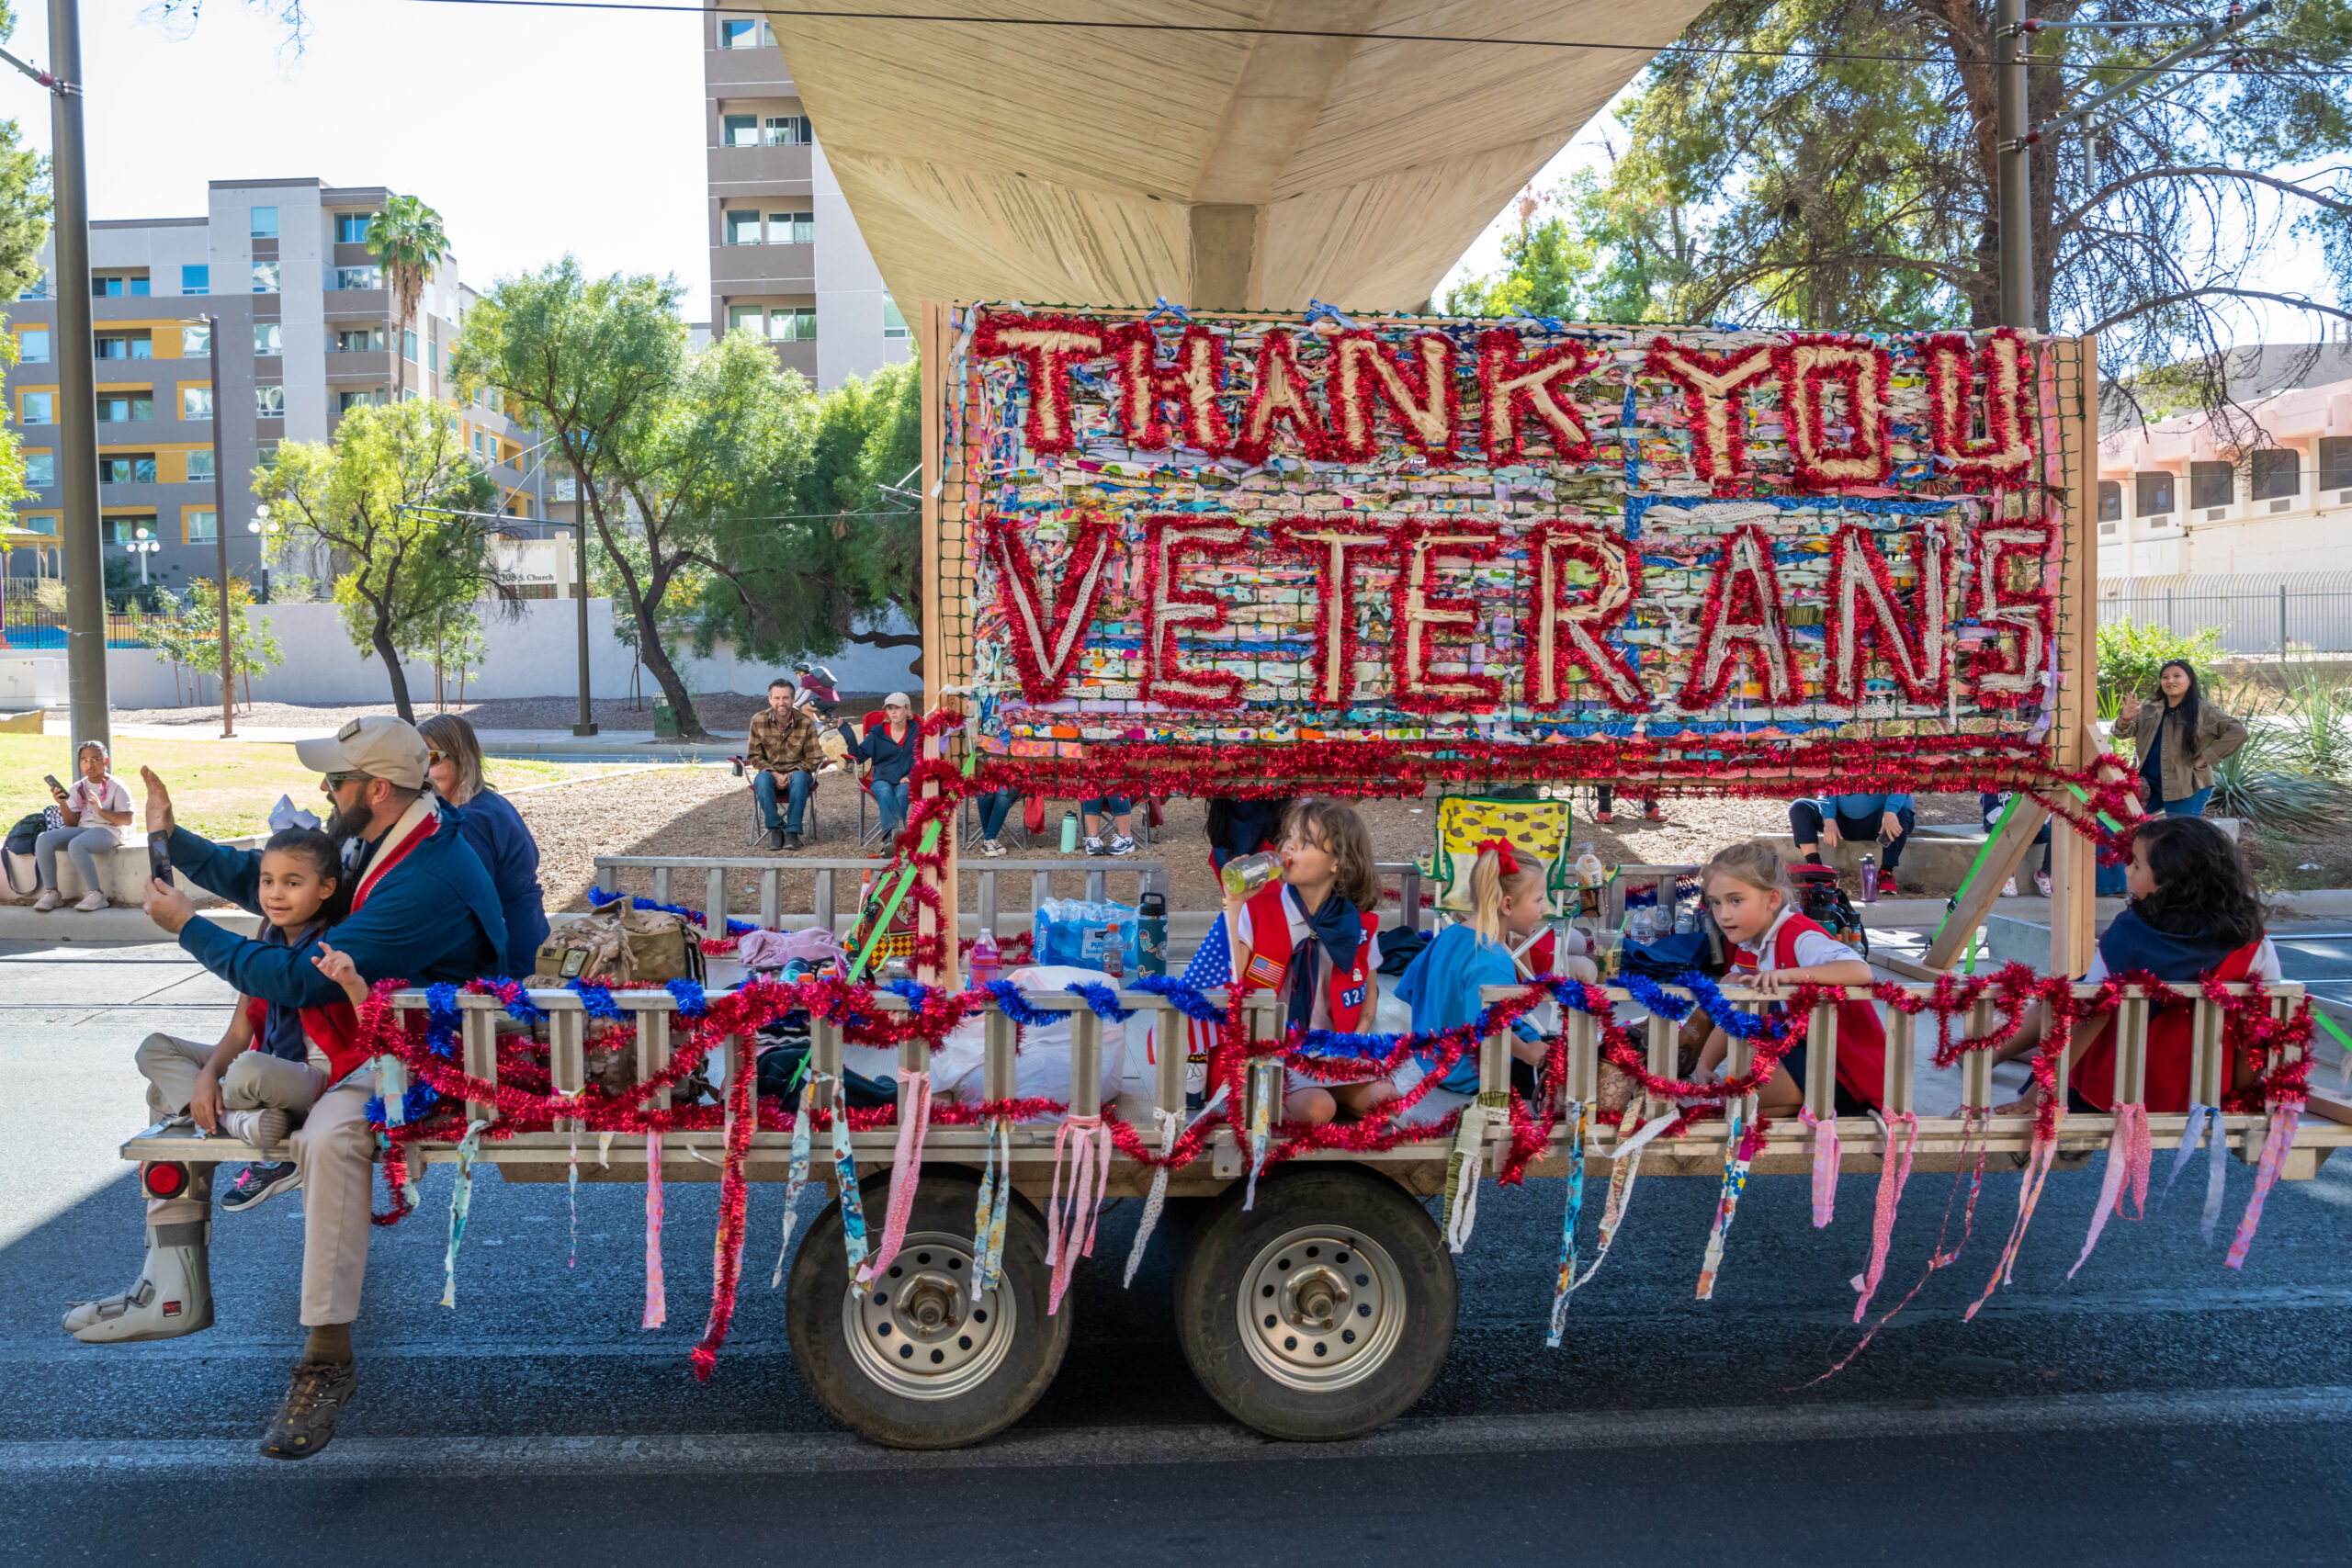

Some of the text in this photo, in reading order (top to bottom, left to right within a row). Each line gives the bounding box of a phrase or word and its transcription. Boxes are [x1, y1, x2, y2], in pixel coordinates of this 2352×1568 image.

[976, 312, 2033, 488] THANK YOU
[986, 513, 2056, 715] VETERANS
